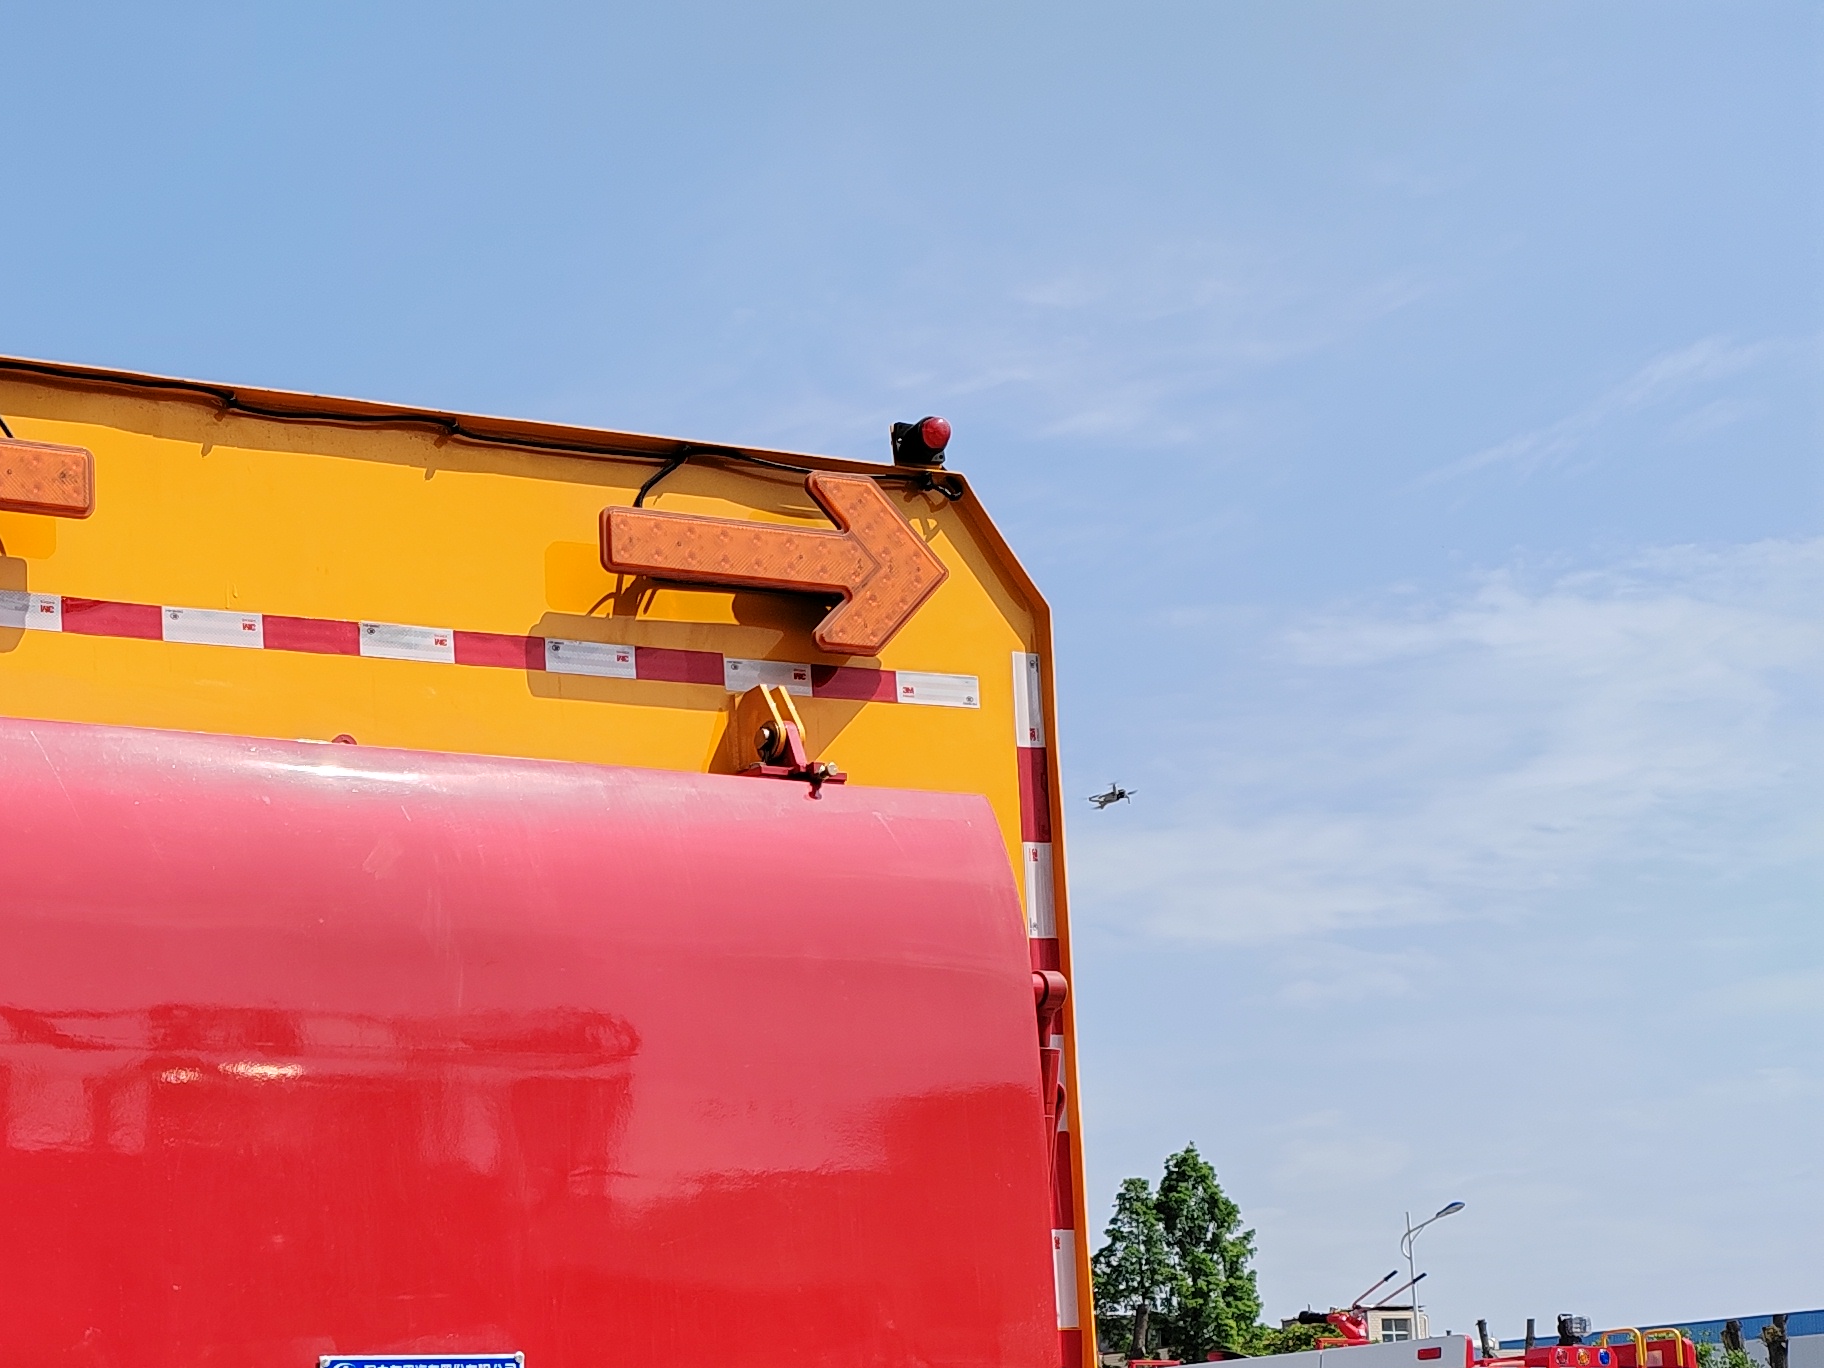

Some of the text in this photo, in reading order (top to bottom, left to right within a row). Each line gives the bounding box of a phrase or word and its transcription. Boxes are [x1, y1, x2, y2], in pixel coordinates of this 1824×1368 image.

[39, 605, 55, 615] 3M
[241, 622, 256, 632] 3M
[433, 637, 447, 647] 3M
[902, 686, 915, 695] 3M
